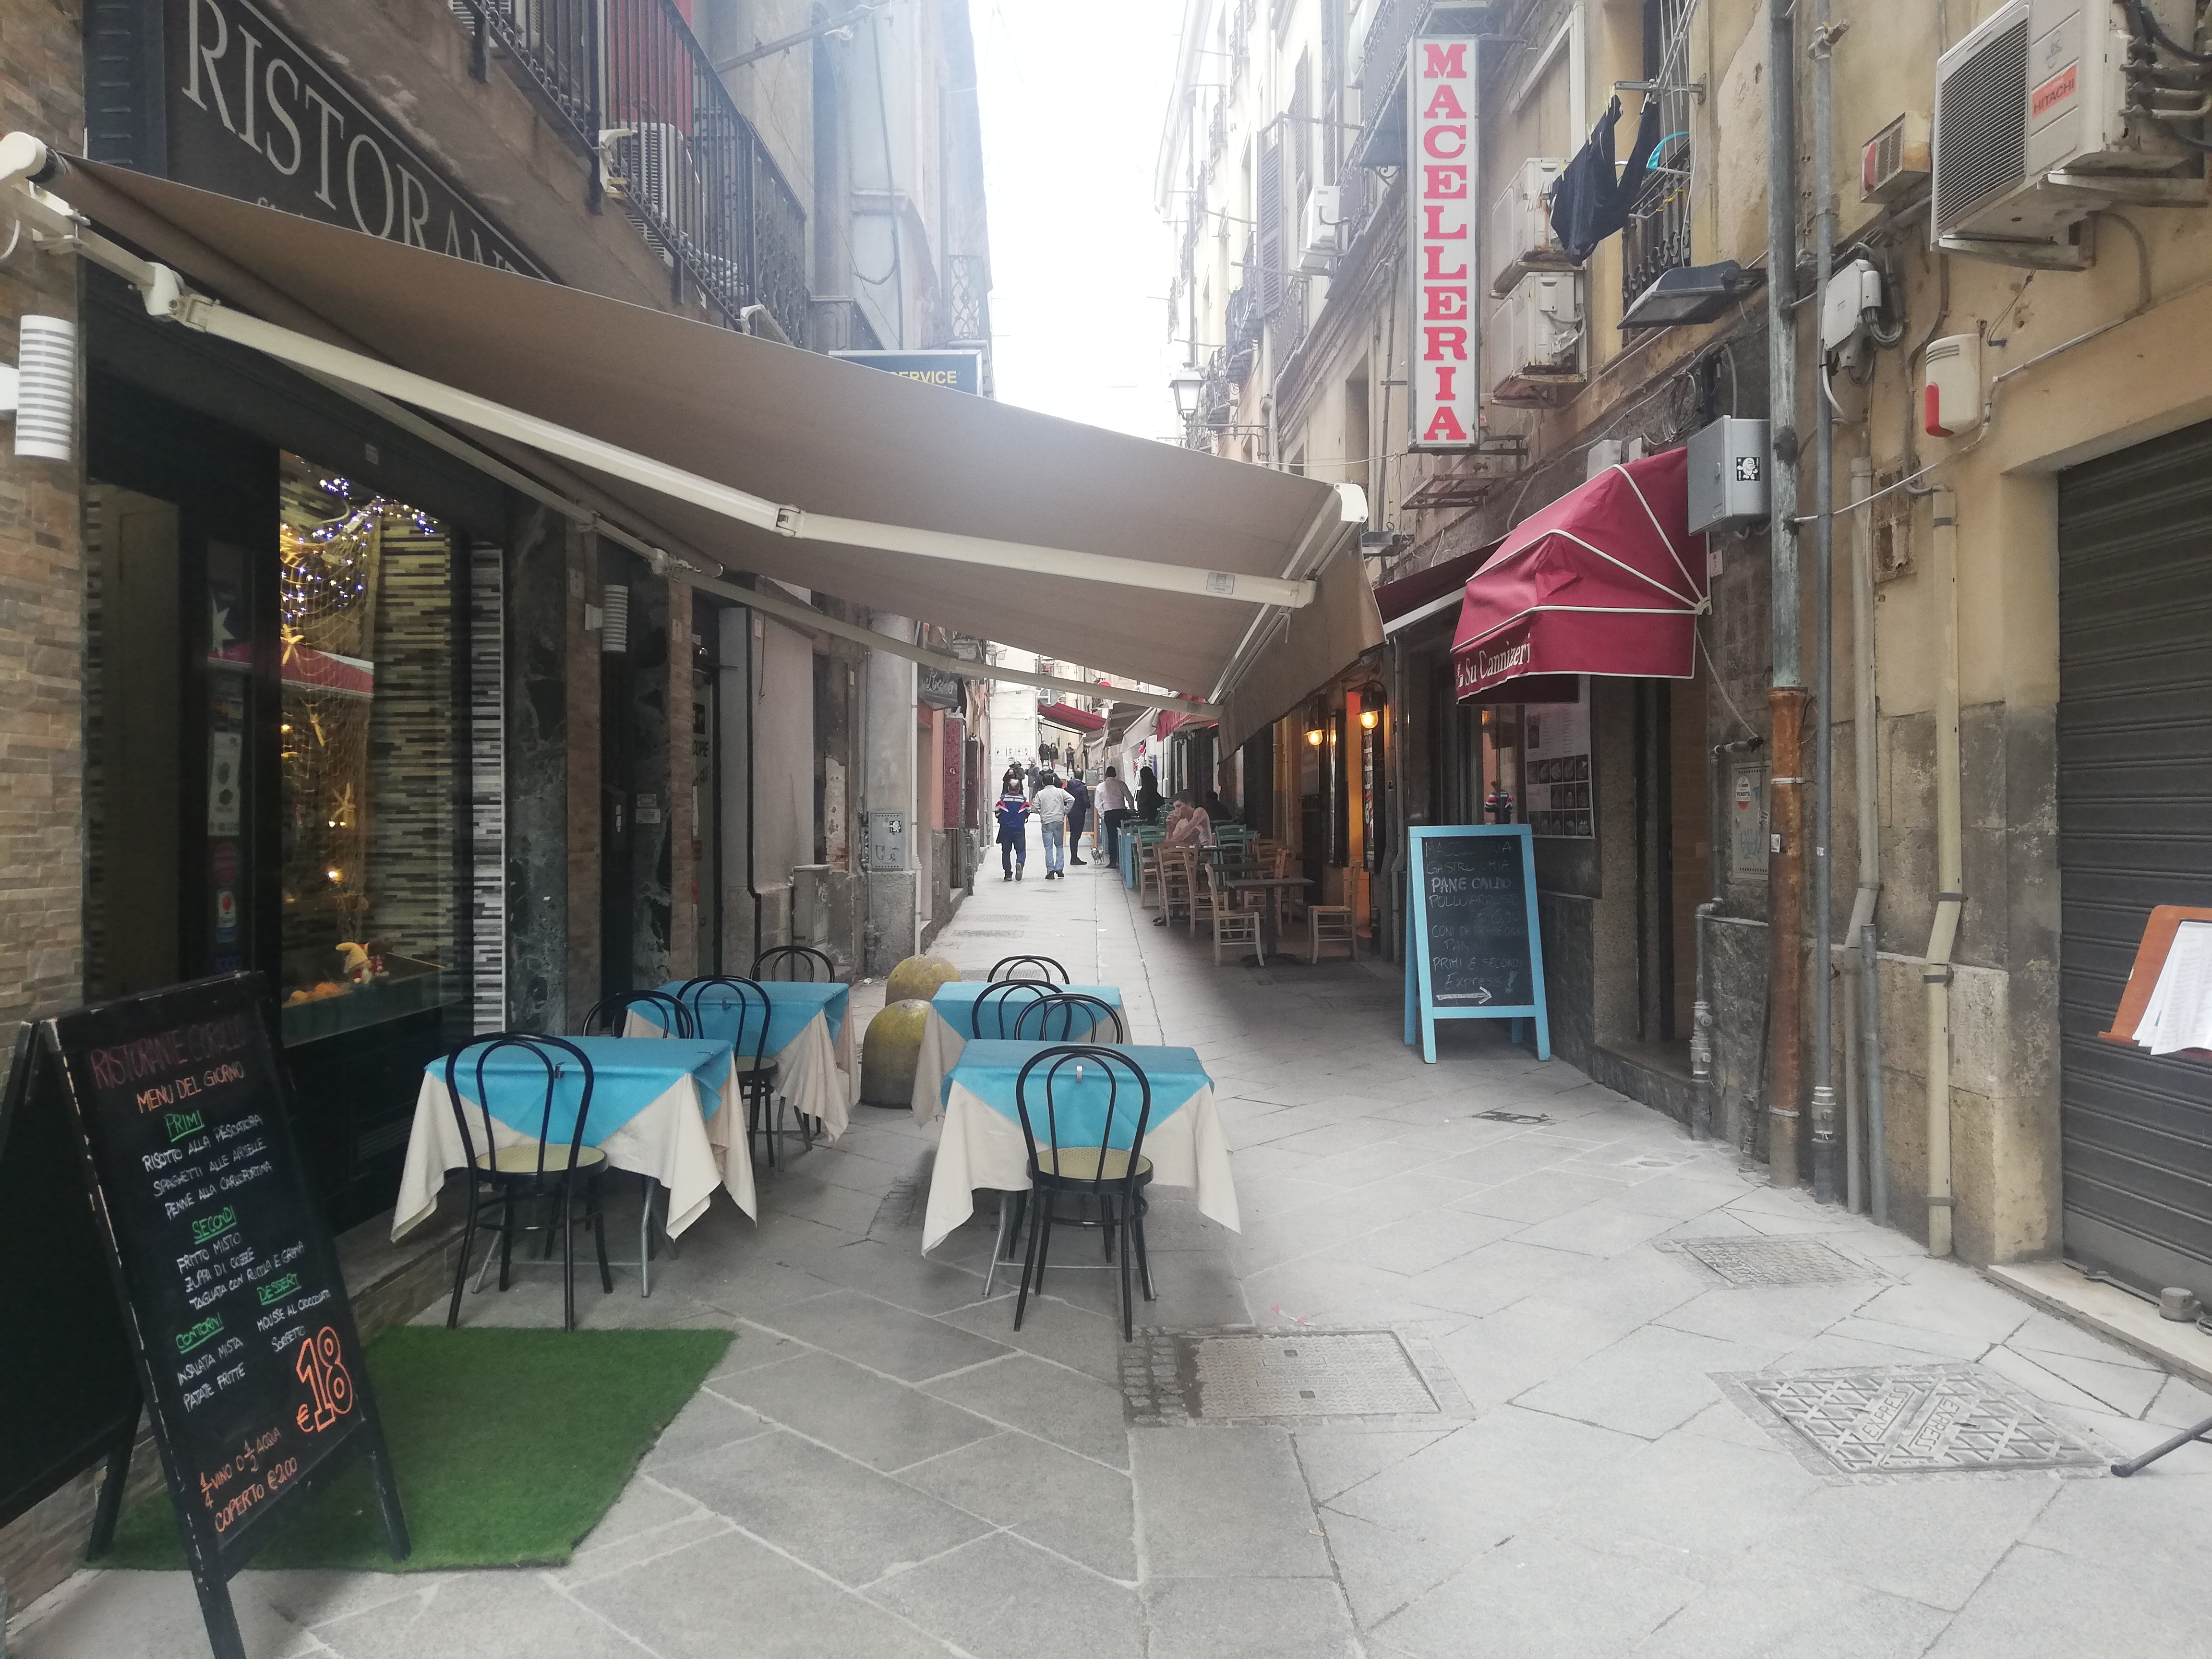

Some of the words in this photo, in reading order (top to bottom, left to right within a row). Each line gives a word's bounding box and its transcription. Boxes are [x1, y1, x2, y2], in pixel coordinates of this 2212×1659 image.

[2033, 78, 2074, 113] HITACHI
[1423, 44, 1467, 440] MACELLERIA
[890, 371, 957, 384] RVICE
[1465, 658, 1478, 686] Su
[1479, 632, 1530, 679] Cannizeri
[1428, 894, 1467, 908] POLLO
[1431, 877, 1467, 893] PANE
[1472, 877, 1511, 890] CALDO
[1432, 957, 1462, 972] PRIMI
[136, 1084, 174, 1114] MENU
[175, 1076, 203, 1099] DEL
[203, 1060, 246, 1087] GIORNO
[164, 1109, 205, 1139] PRIMI
[142, 1148, 183, 1172] RISOTTO
[188, 1135, 211, 1155] ALLA
[153, 1166, 204, 1197] SPAGHETTI
[209, 1154, 230, 1172] ALLE
[165, 1192, 195, 1221] PENNE
[198, 1184, 217, 1200] ALLA
[192, 1205, 238, 1239] SECONDI
[177, 1249, 210, 1274] FRITTO
[213, 1232, 242, 1255] MISTO
[184, 1268, 213, 1293] ZUPPA
[214, 1262, 227, 1277] DI
[189, 1284, 228, 1310] TAGLIATA
[228, 1274, 244, 1291] CON
[273, 1253, 282, 1268] E
[256, 1273, 301, 1304] DESSERT
[176, 1311, 223, 1350] CONTORNI
[256, 1308, 286, 1333] MOUSSE
[287, 1303, 298, 1317] AL
[177, 1354, 216, 1386] INSALATA
[217, 1336, 244, 1359] MISTA
[183, 1382, 215, 1413] PATATE
[216, 1361, 246, 1390] FRITTE
[1862, 1387, 1909, 1438] EXPRESS
[1915, 1396, 1960, 1452] EXPRESS
[210, 1463, 233, 1489] VINO
[256, 1427, 281, 1455] ACQUA
[215, 1484, 264, 1533] COPERTO
